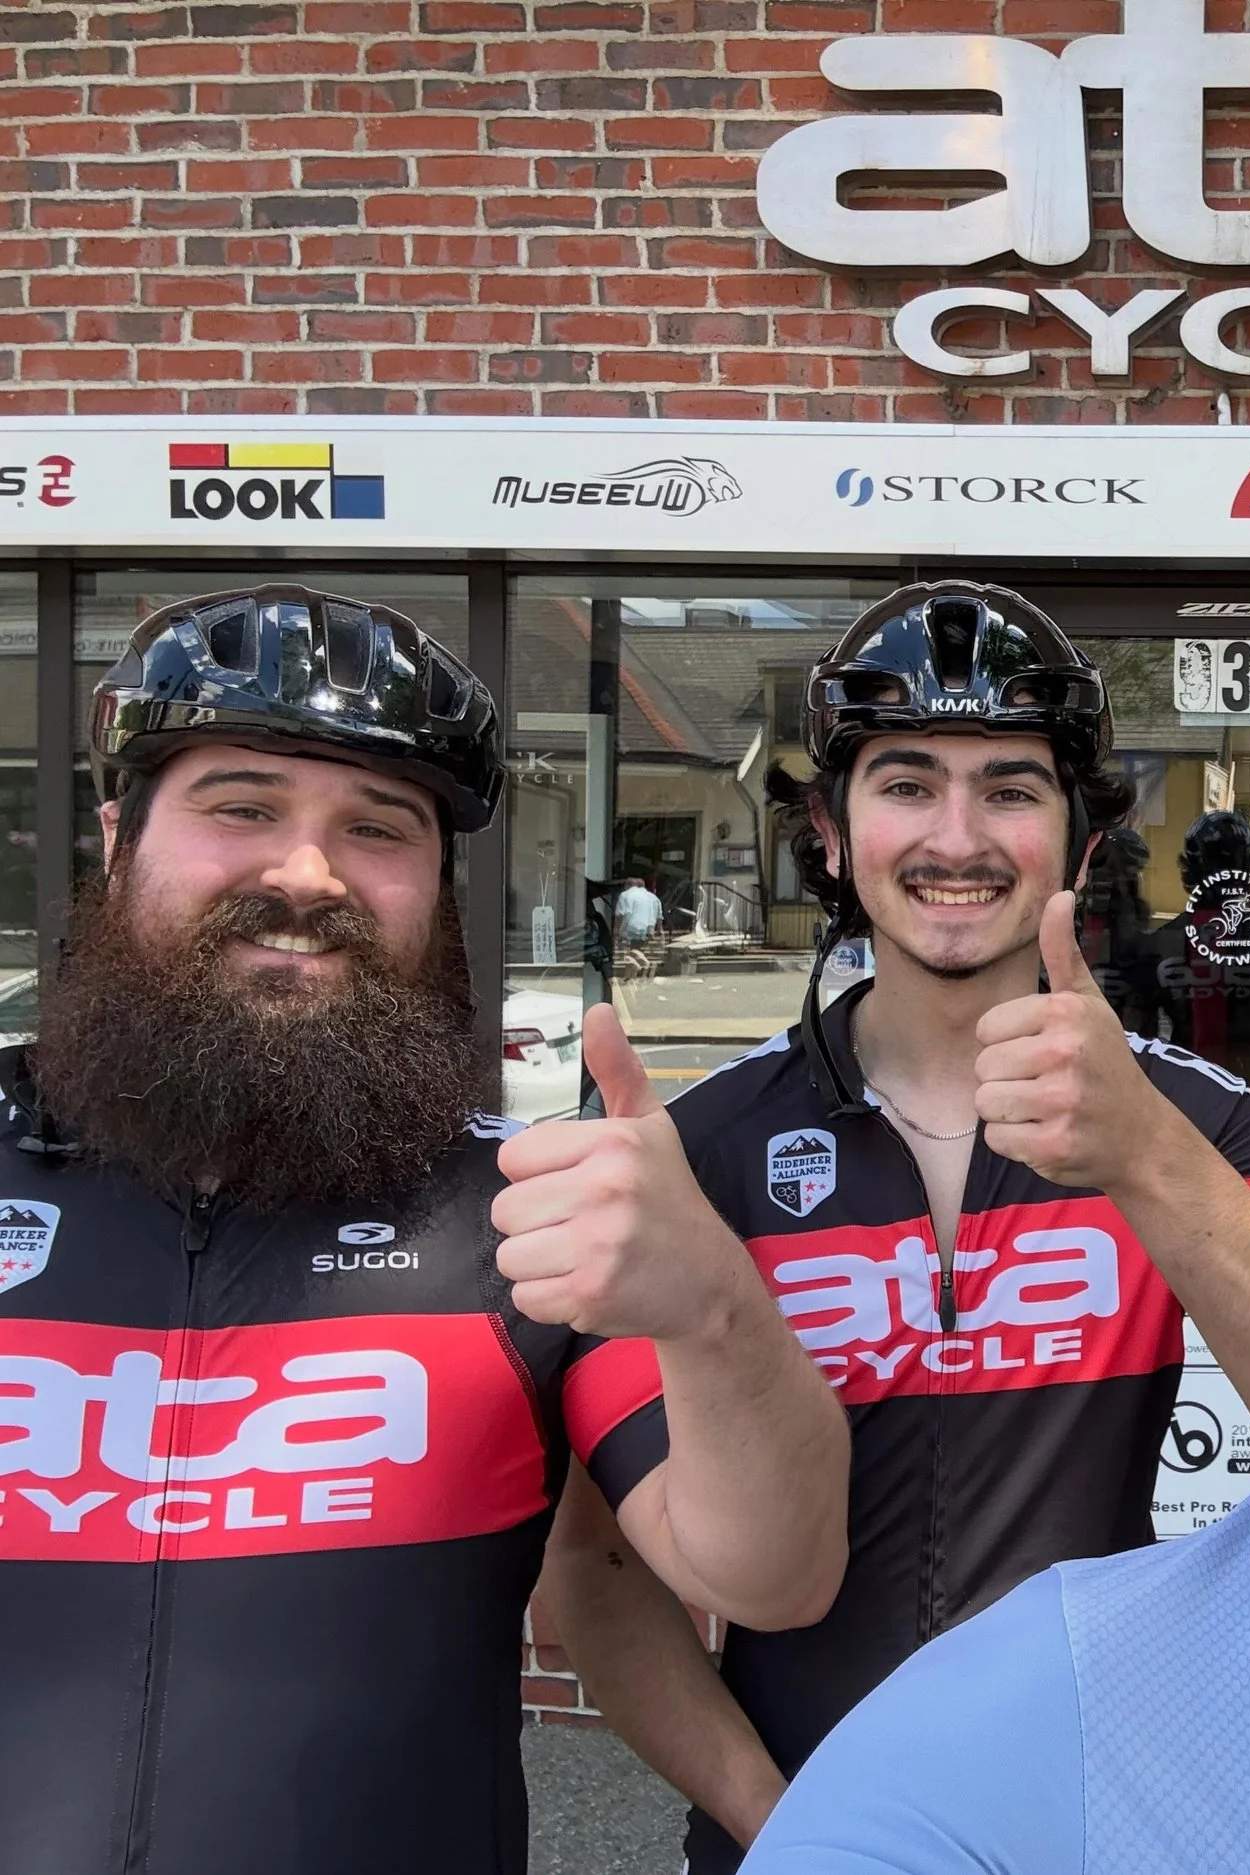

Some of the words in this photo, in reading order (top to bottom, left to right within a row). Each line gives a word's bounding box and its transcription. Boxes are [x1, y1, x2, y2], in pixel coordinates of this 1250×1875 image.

[169, 477, 325, 520] LOOK
[882, 475, 1148, 504] STORCK
[772, 1155, 832, 1169] RIDEBIKER
[773, 1226, 1120, 1350] ata
[0, 1477, 374, 1535] YCLE
[1151, 1501, 1186, 1513] Best
[1190, 1501, 1217, 1513] Pro
